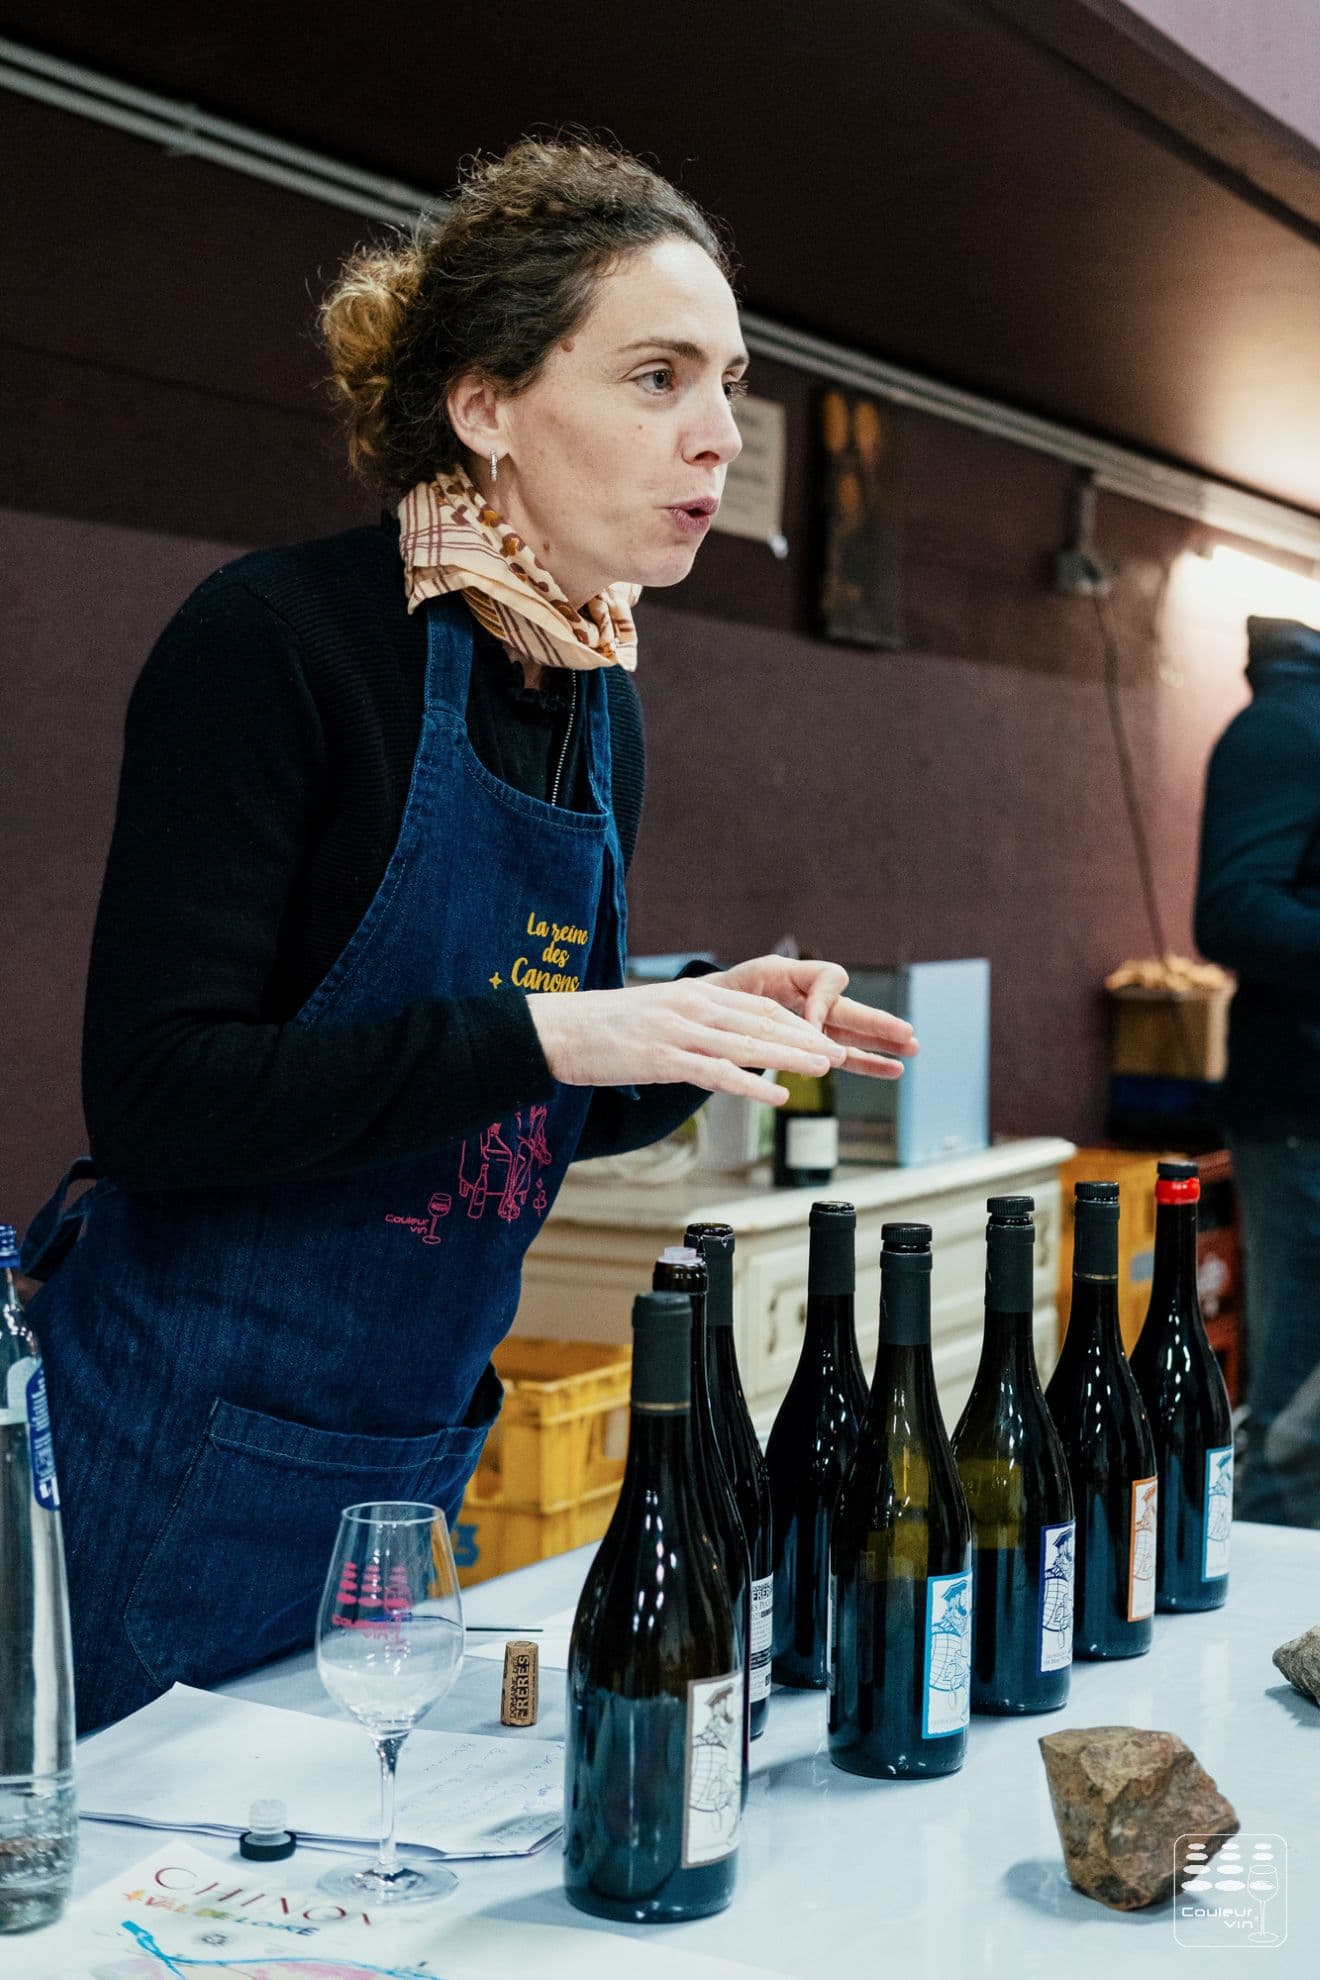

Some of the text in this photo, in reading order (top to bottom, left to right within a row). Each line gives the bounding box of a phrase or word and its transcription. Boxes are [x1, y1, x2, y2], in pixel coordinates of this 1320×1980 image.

[527, 911, 589, 945] La reine
[542, 940, 570, 968] des
[410, 1226, 428, 1234] vin
